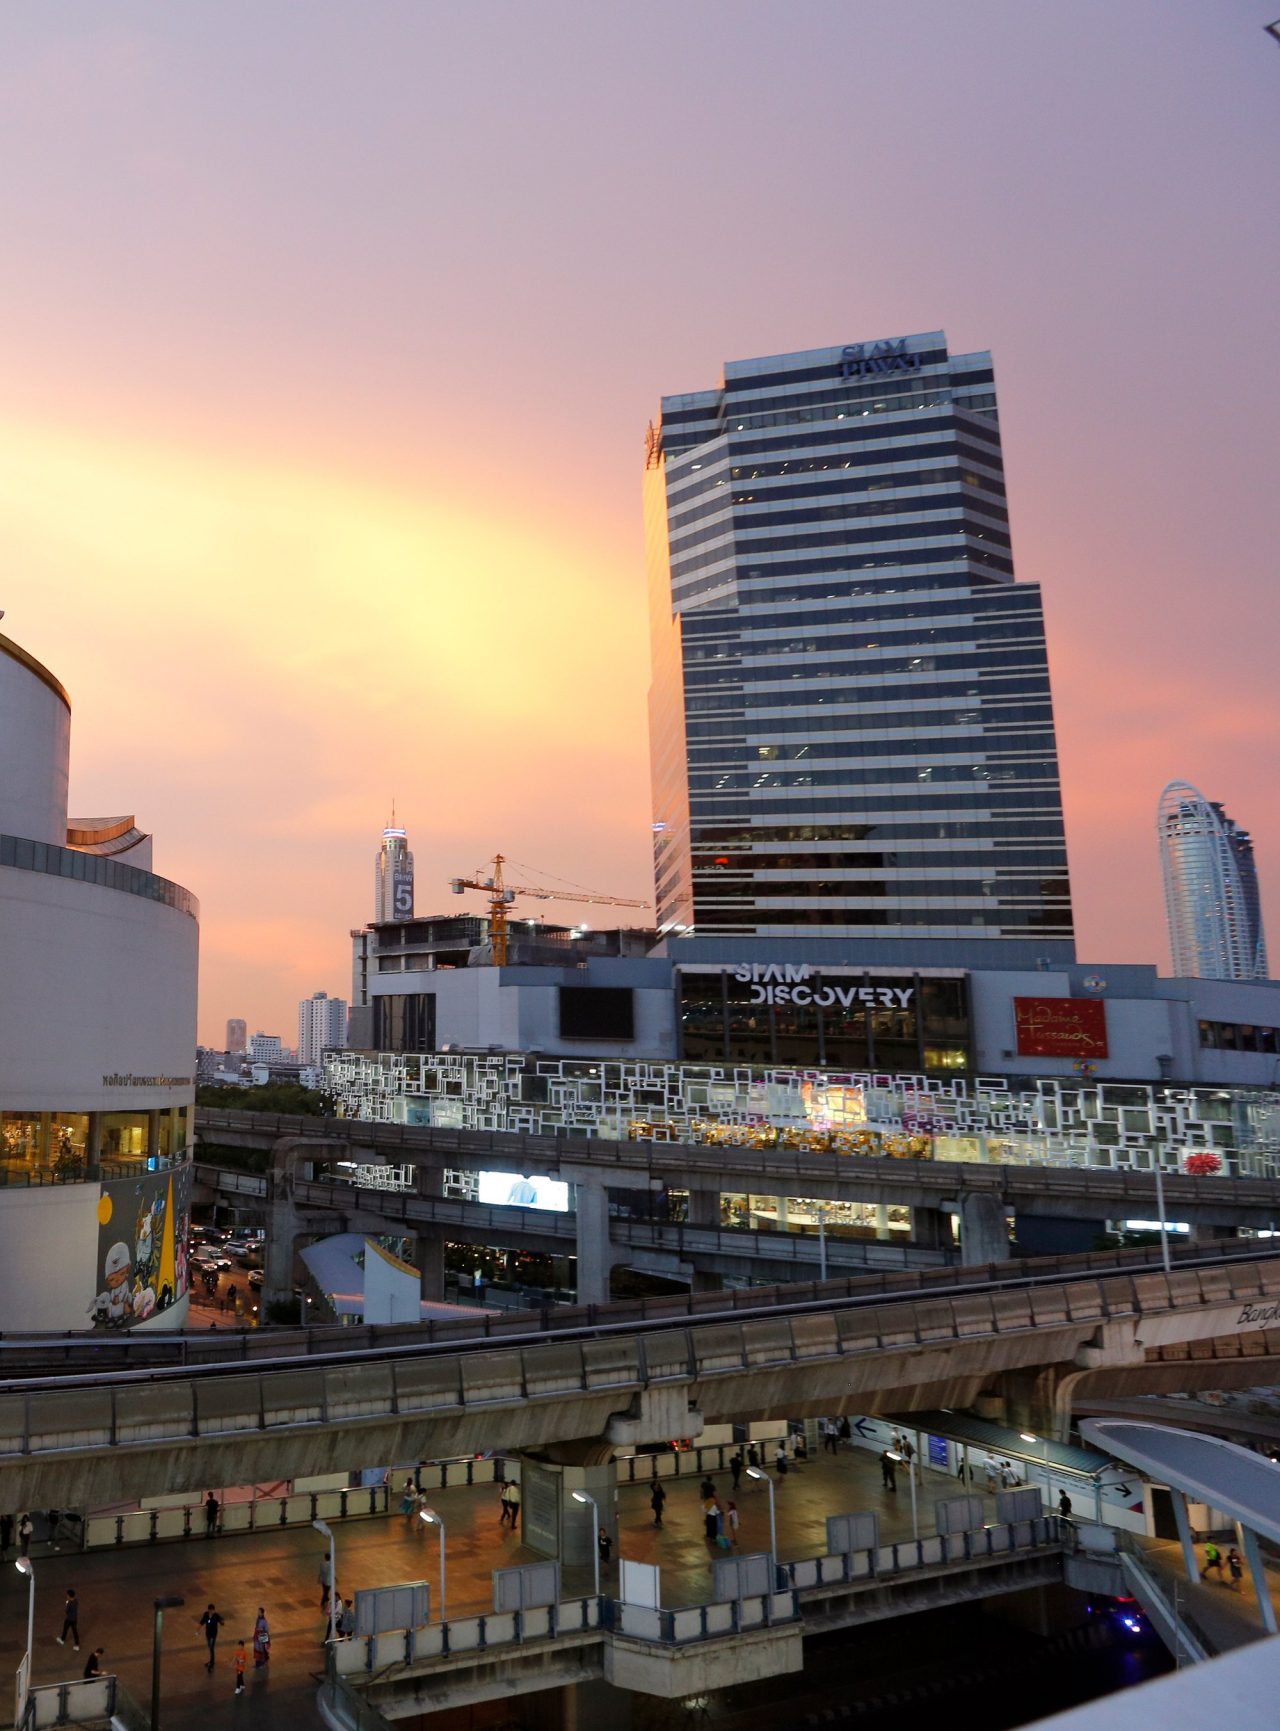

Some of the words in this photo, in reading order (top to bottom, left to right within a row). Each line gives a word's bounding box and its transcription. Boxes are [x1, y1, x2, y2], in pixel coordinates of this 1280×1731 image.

[842, 338, 907, 360] SIAM
[734, 962, 810, 983] SIAM
[750, 985, 915, 1008] DISCOVERY
